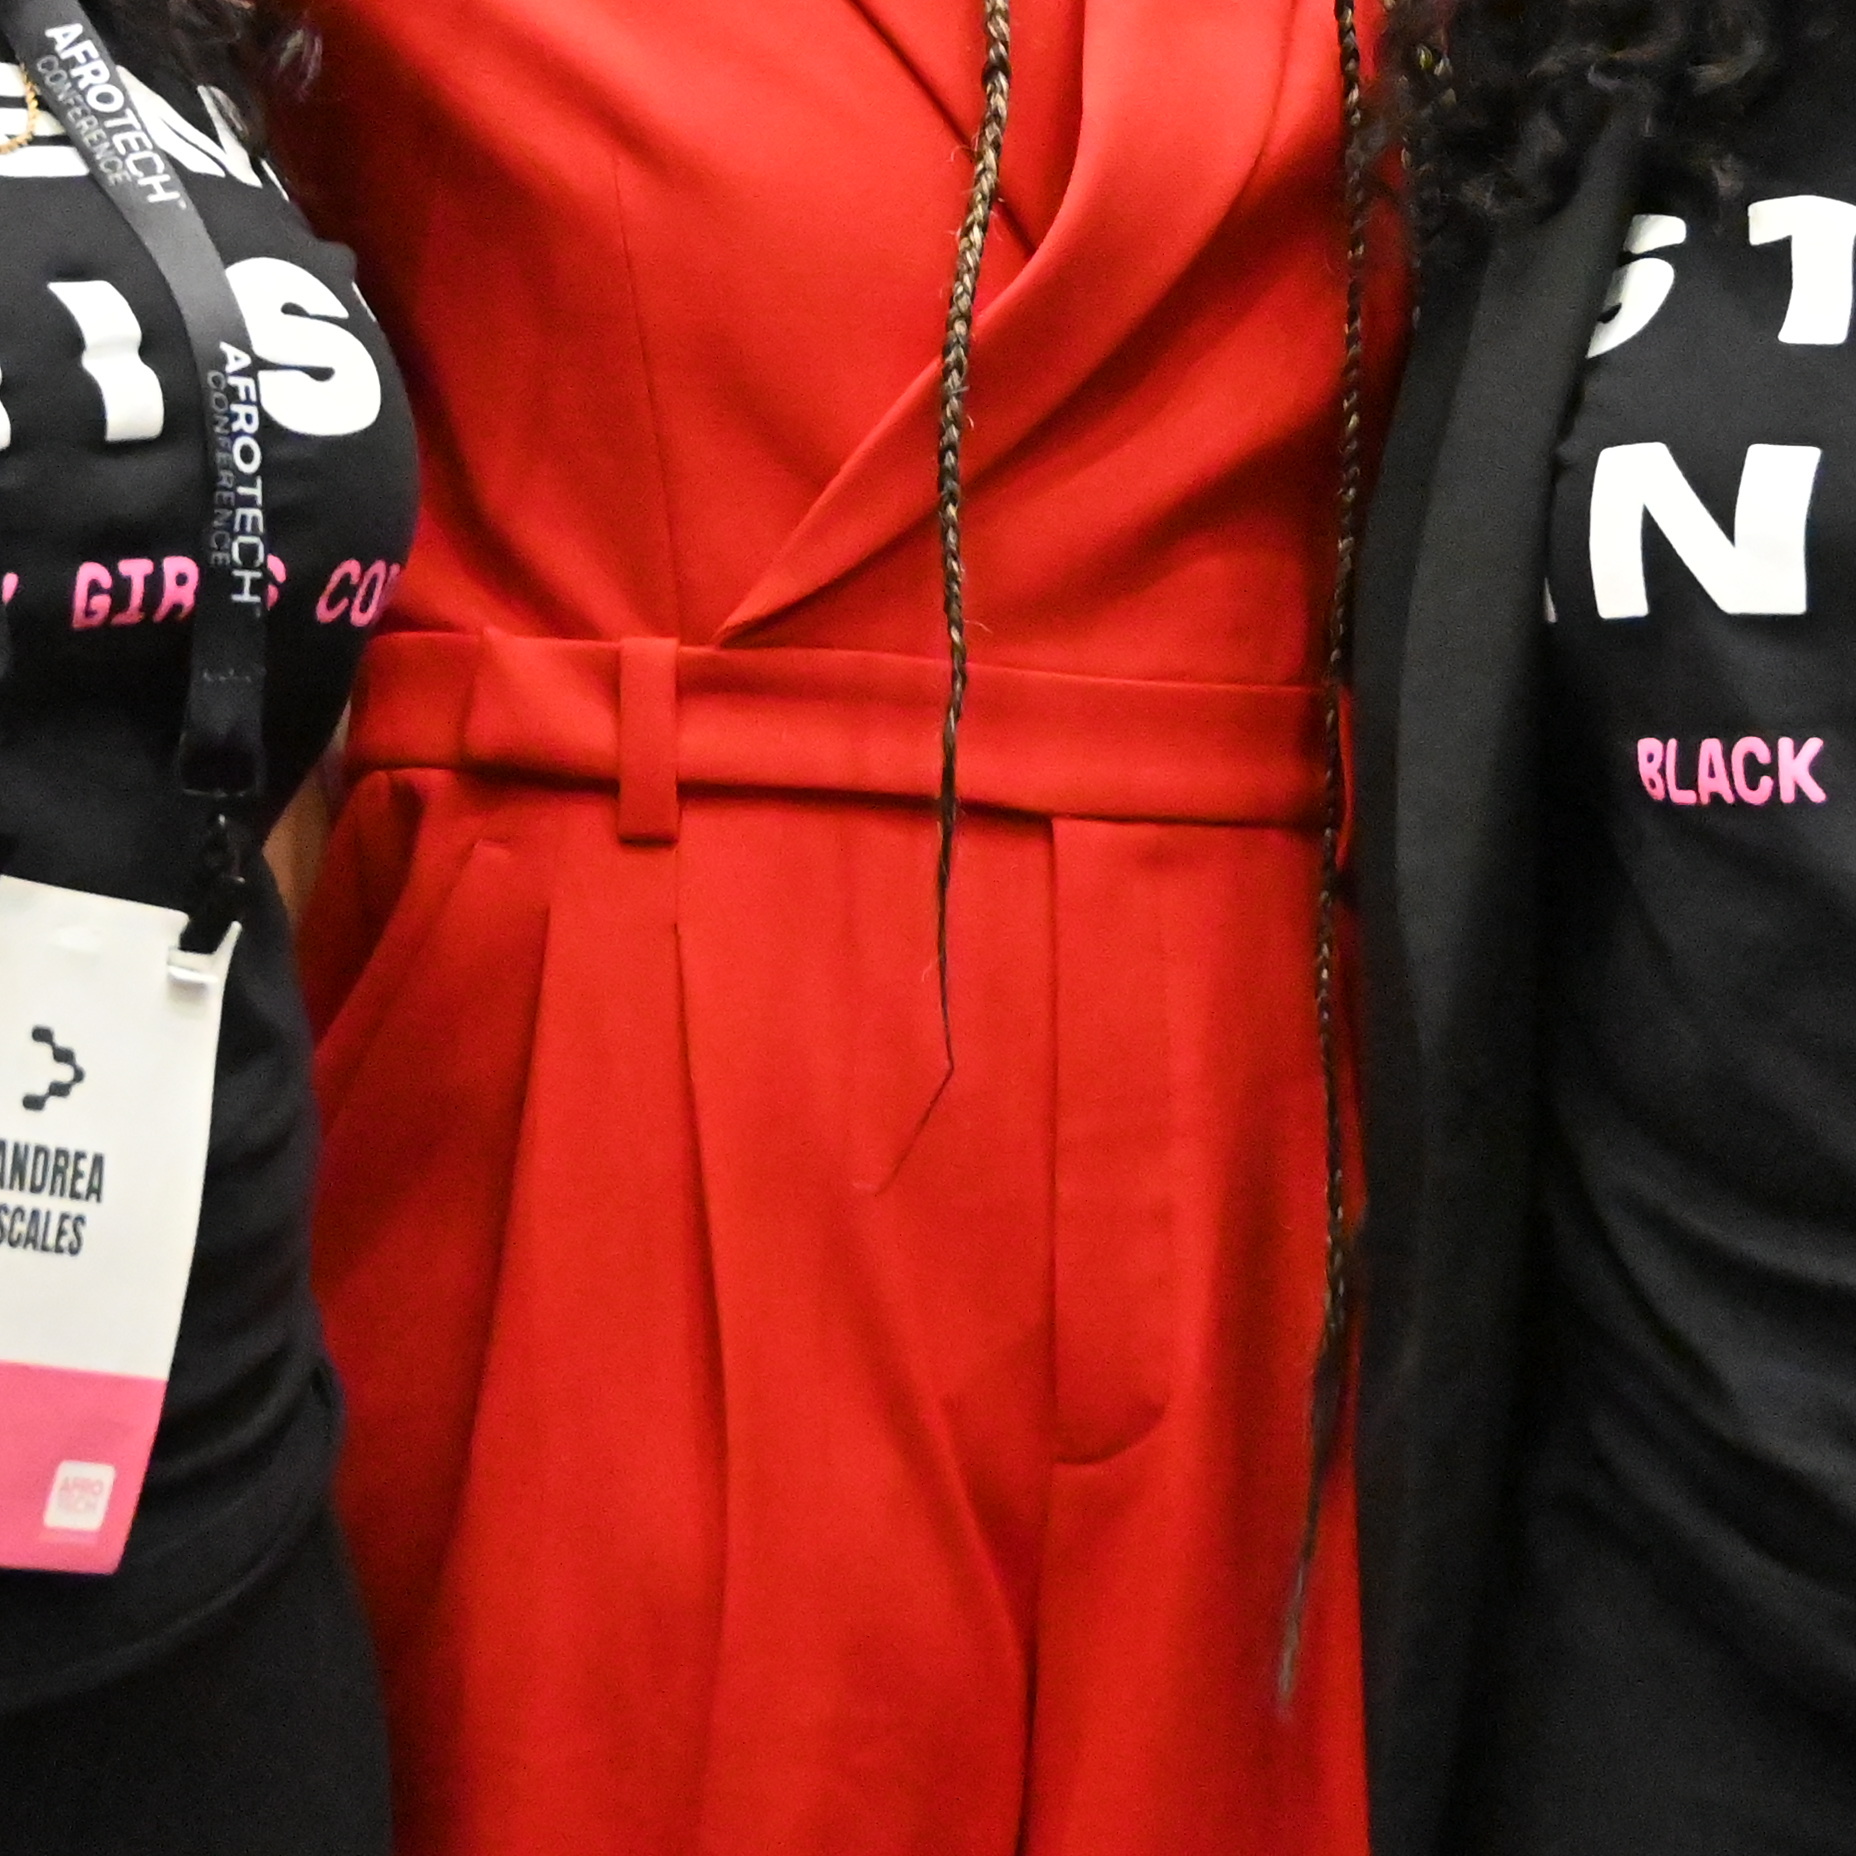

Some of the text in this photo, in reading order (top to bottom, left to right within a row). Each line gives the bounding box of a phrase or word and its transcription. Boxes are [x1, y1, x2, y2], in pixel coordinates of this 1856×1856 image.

[36, 54, 132, 187] CONFERENCE
[44, 22, 181, 203] AFROTECH
[207, 369, 235, 567] CONFERENCE
[219, 341, 265, 604] AFROTECH
[71, 554, 287, 632] GIR
[316, 558, 402, 627] CO
[1637, 735, 1827, 807] BLACK
